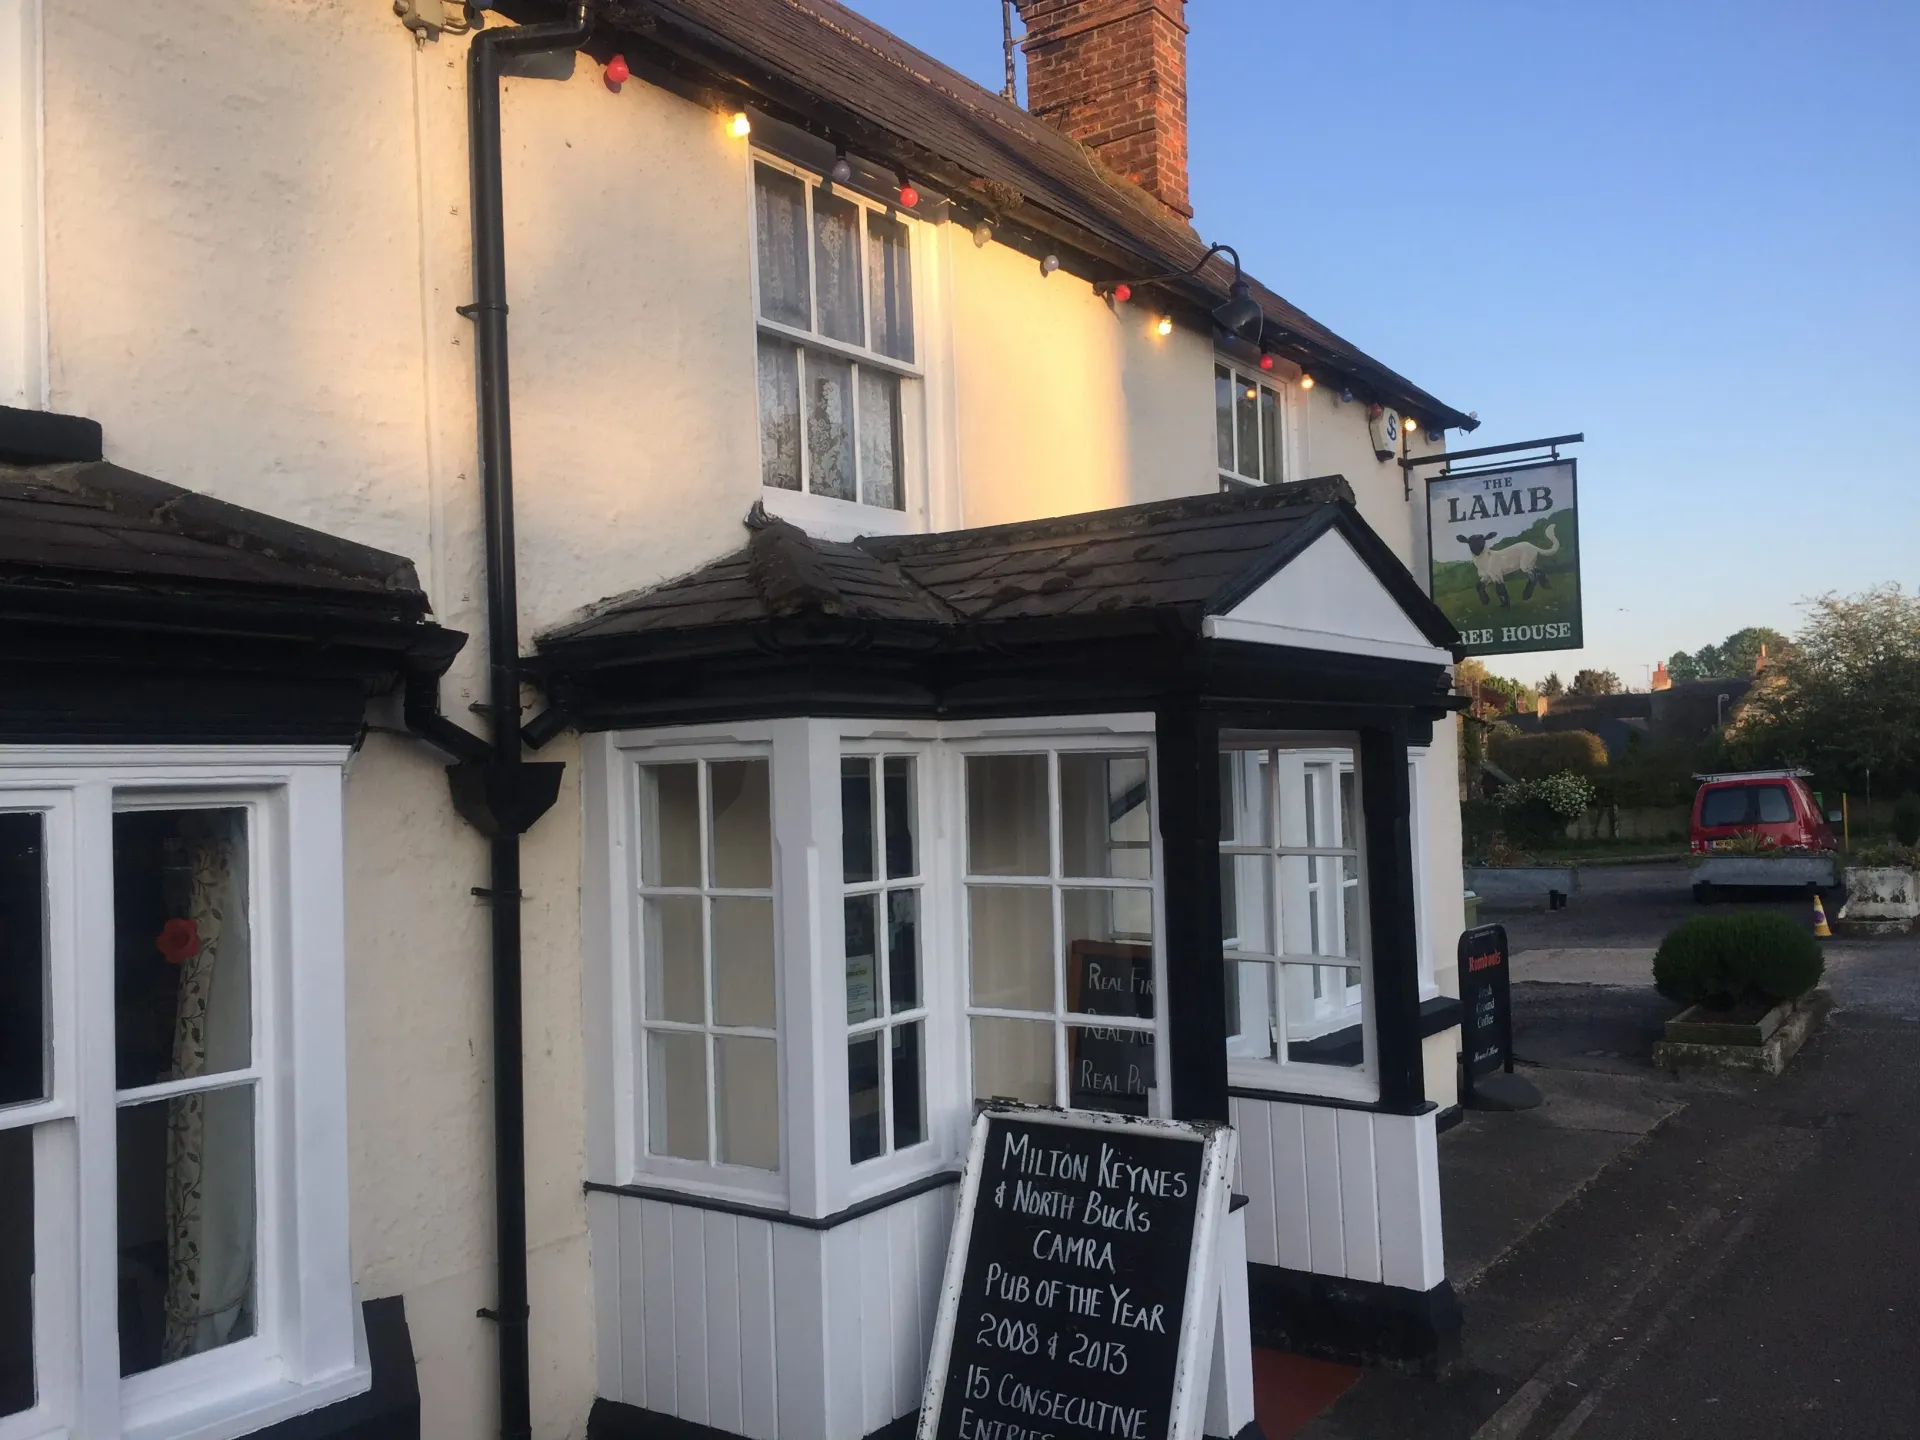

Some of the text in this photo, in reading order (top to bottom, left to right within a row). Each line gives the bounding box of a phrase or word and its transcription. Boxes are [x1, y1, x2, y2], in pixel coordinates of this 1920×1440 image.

[1483, 477, 1512, 490] THE
[1447, 486, 1553, 523] LAMB
[1456, 622, 1571, 645] REE HOUSE
[1130, 967, 1153, 995] FIR
[1081, 1059, 1122, 1093] REAL
[1001, 1132, 1188, 1198] MILTON KEYNES
[994, 1182, 1008, 1208] &
[1013, 1180, 1075, 1220] NORTH
[1033, 1229, 1116, 1274] CAMRA
[985, 1262, 1166, 1334] PUB OF THE YEAR
[976, 1313, 1128, 1375] 2008 & 2013
[965, 1364, 990, 1400] 15
